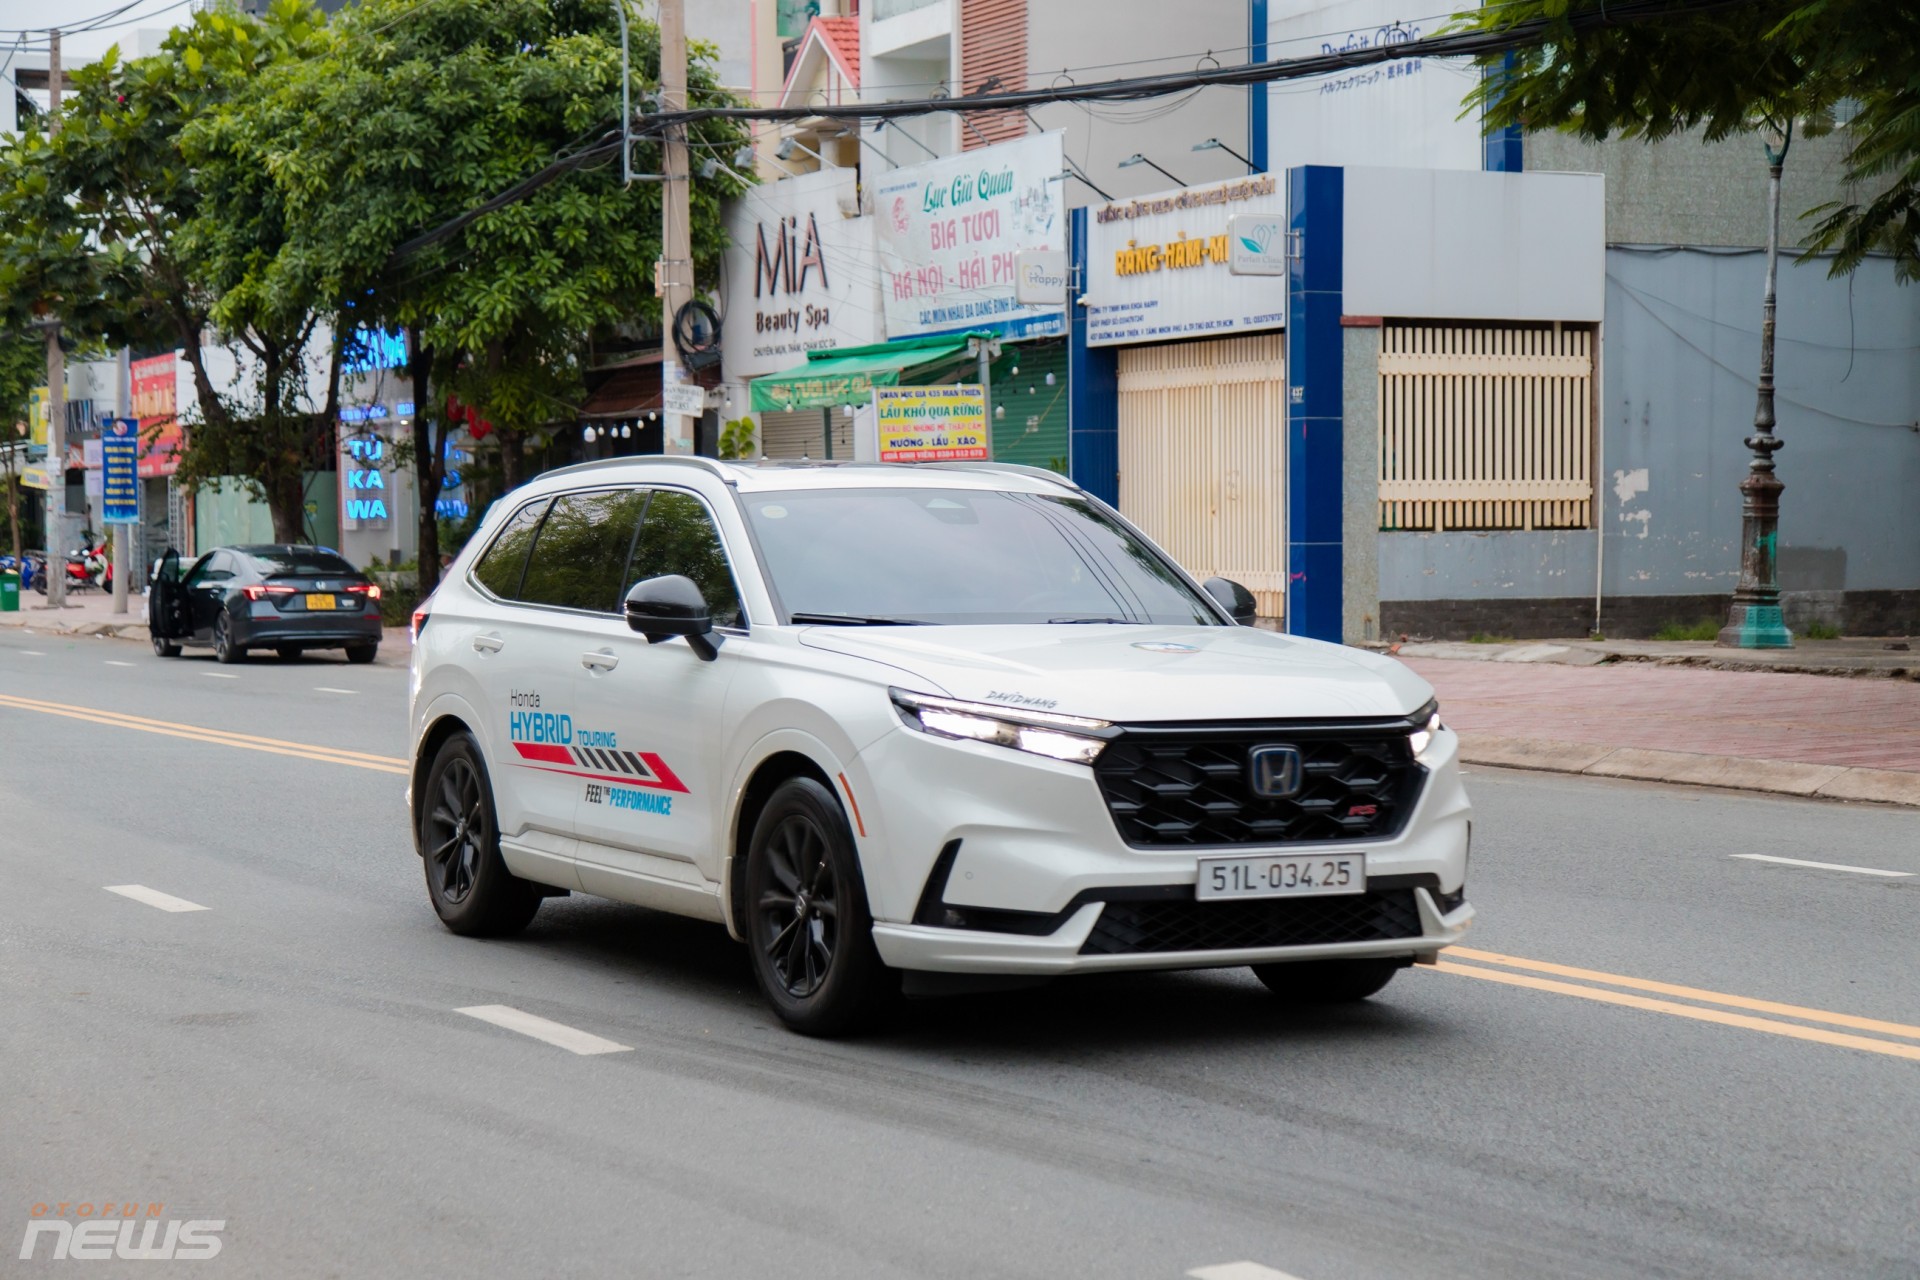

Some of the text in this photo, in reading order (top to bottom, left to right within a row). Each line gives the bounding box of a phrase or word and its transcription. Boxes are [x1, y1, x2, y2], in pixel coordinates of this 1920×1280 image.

[923, 180, 947, 215] Lục
[977, 164, 1014, 200] Quán
[930, 218, 956, 250] BIA
[892, 265, 913, 301] HÀ
[917, 260, 944, 304] NỘI
[959, 250, 986, 290] HẢI
[1029, 272, 1064, 287] Happy
[756, 304, 829, 333] Beauty Spa
[928, 405, 950, 419] QUA
[348, 469, 384, 489] KA
[347, 499, 387, 519] WA
[510, 689, 540, 708] Honda
[510, 711, 617, 748] HYBRID TOURING
[585, 783, 602, 804] FEEL
[610, 787, 672, 815] PERFORMANCE
[1349, 804, 1377, 816] RS
[1212, 861, 1351, 892] 51L-034.25
